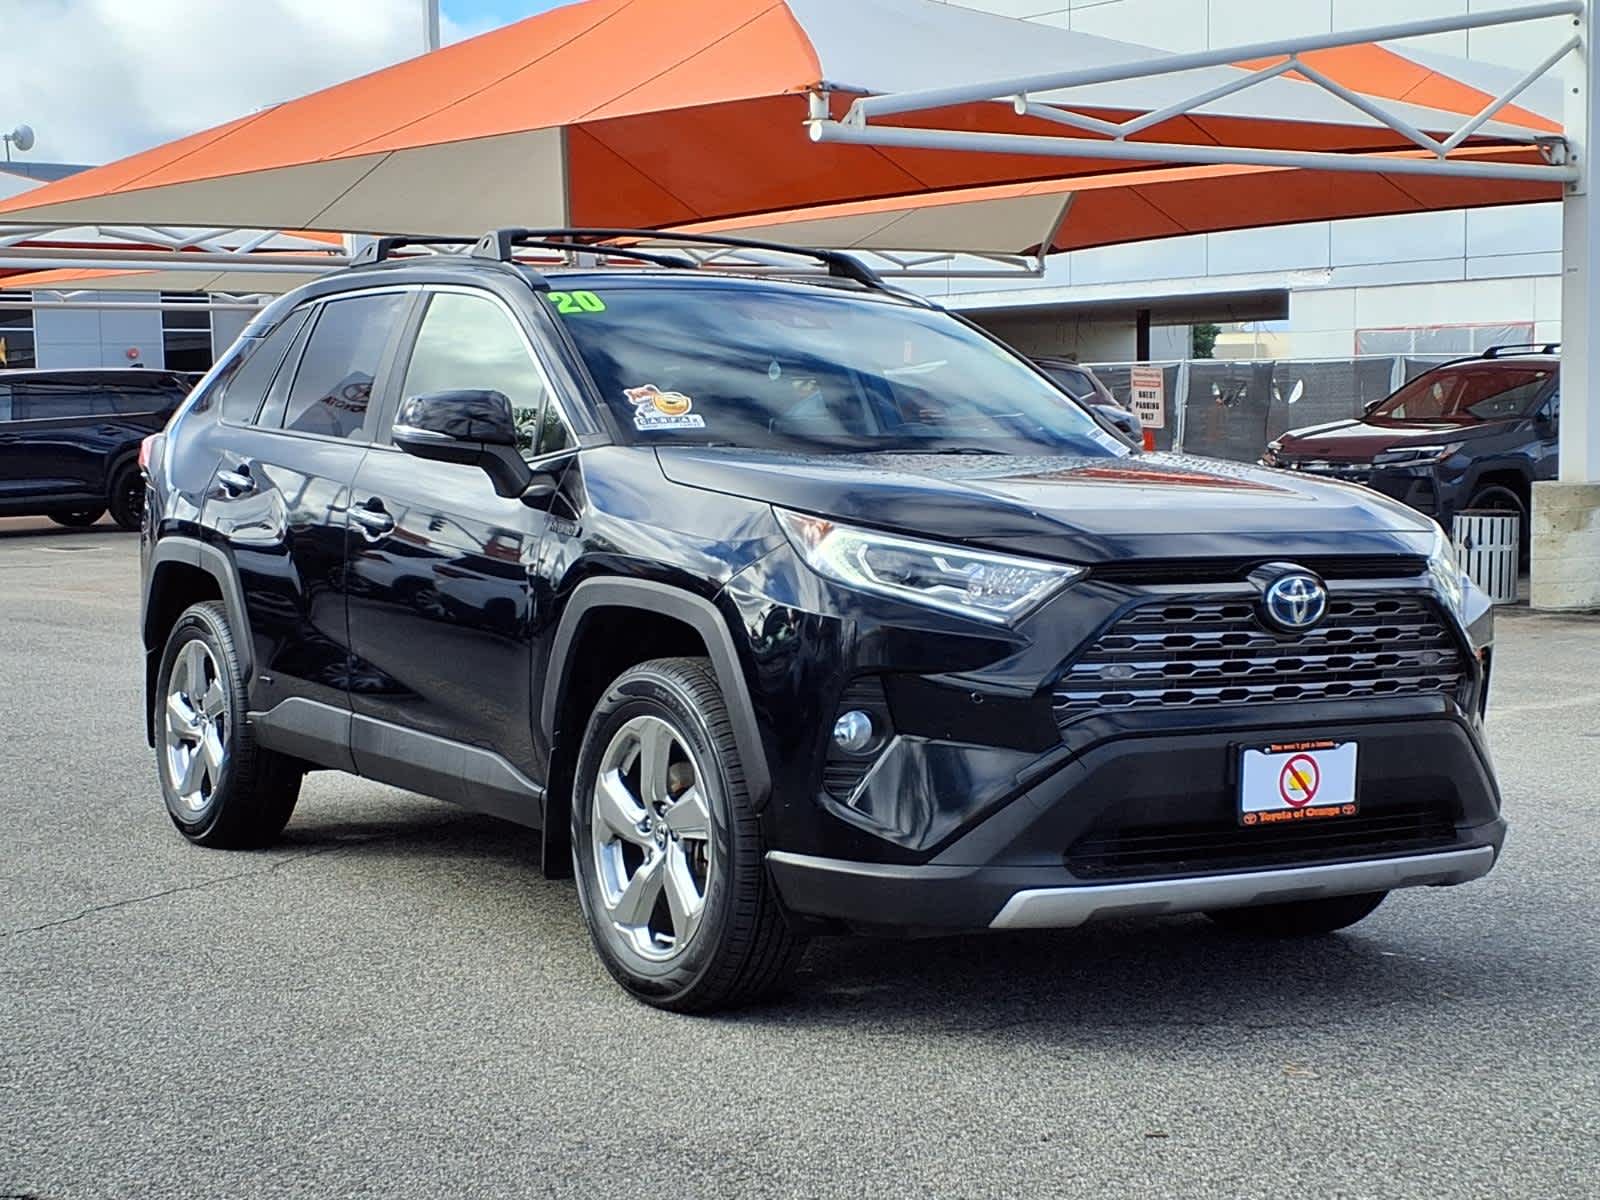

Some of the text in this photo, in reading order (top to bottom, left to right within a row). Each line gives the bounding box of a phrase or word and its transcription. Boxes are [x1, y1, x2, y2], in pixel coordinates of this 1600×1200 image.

[547, 290, 607, 314] 20
[1135, 401, 1160, 410] PARKING
[1140, 412, 1154, 420] ONLY
[1258, 811, 1292, 822] Toyota
[1293, 809, 1304, 818] of
